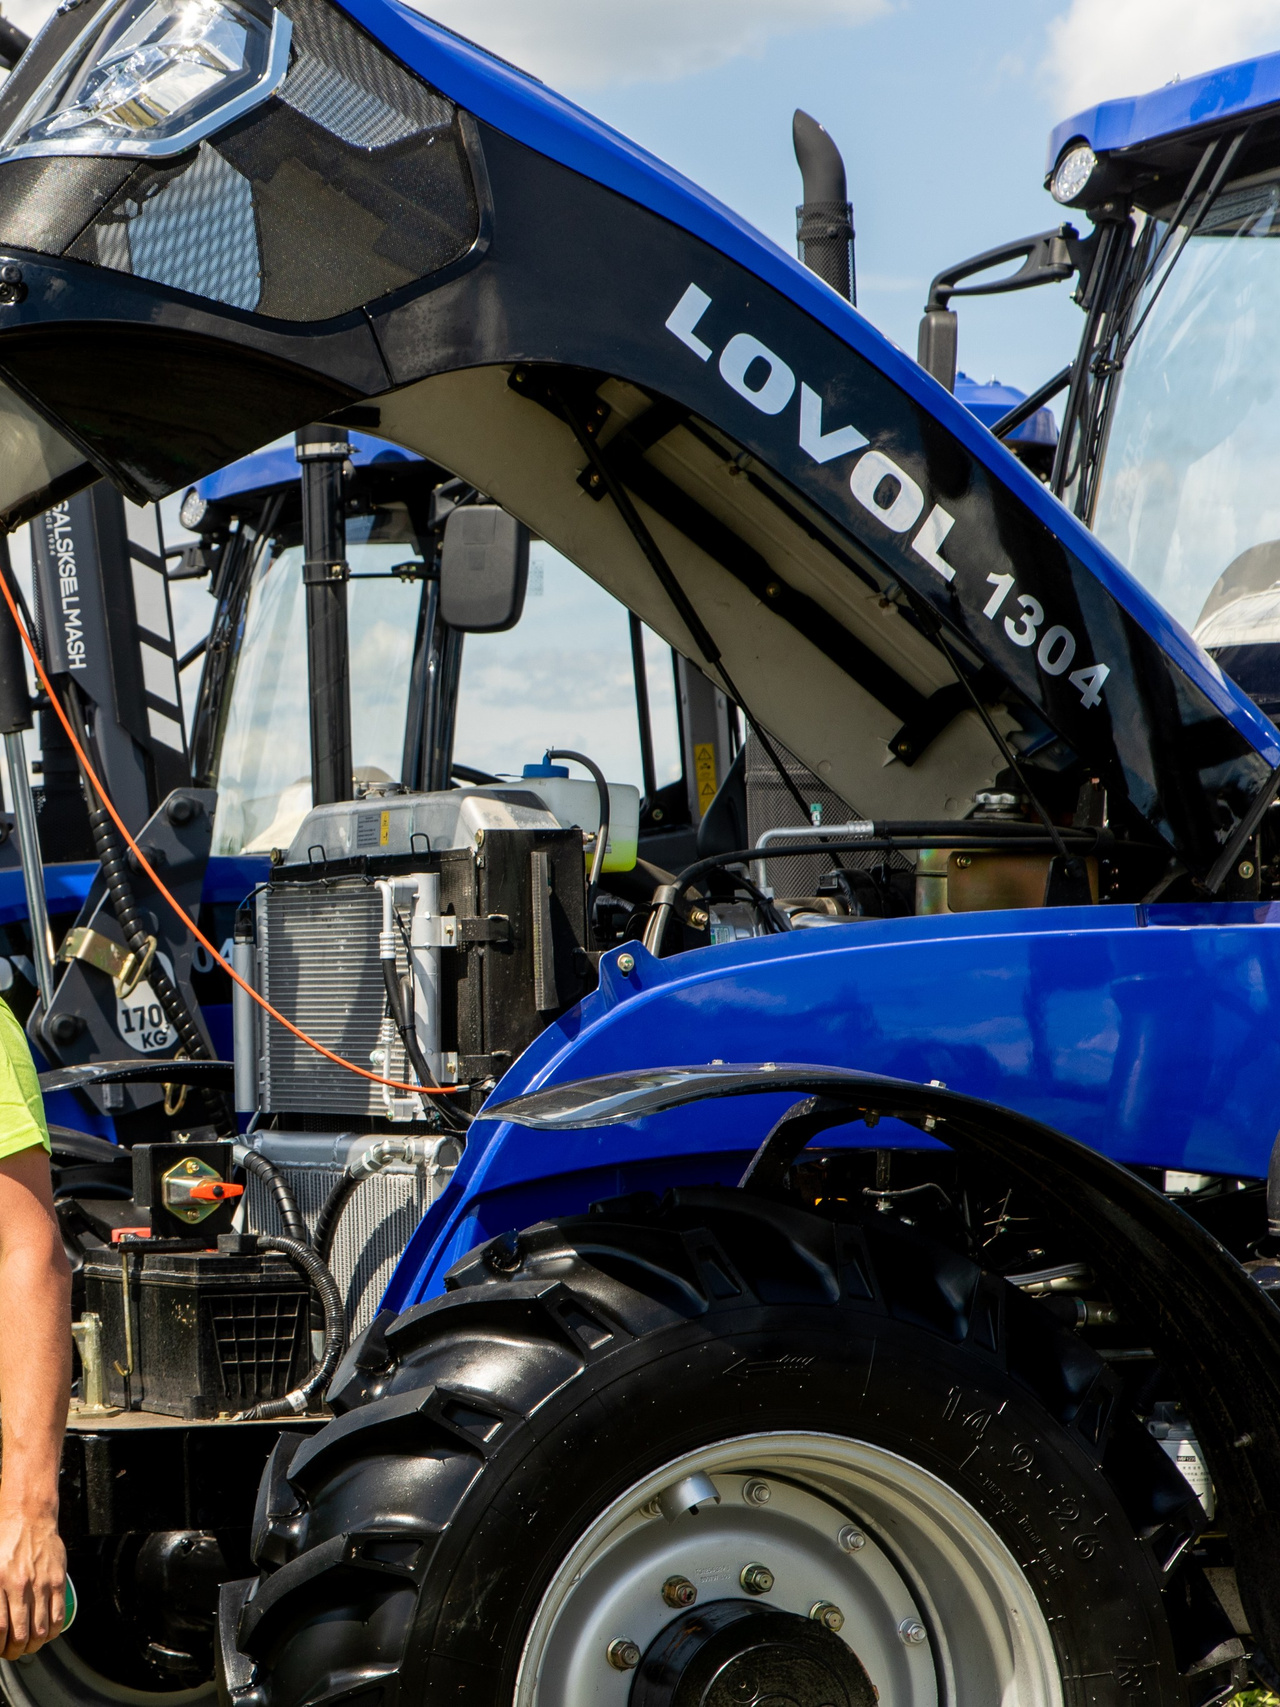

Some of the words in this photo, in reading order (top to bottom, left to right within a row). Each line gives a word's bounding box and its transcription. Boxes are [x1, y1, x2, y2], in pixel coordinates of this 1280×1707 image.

[665, 282, 957, 582] LOVOL
[983, 572, 1111, 709] 1304
[121, 1003, 163, 1034] 170
[141, 1029, 168, 1049] KG
